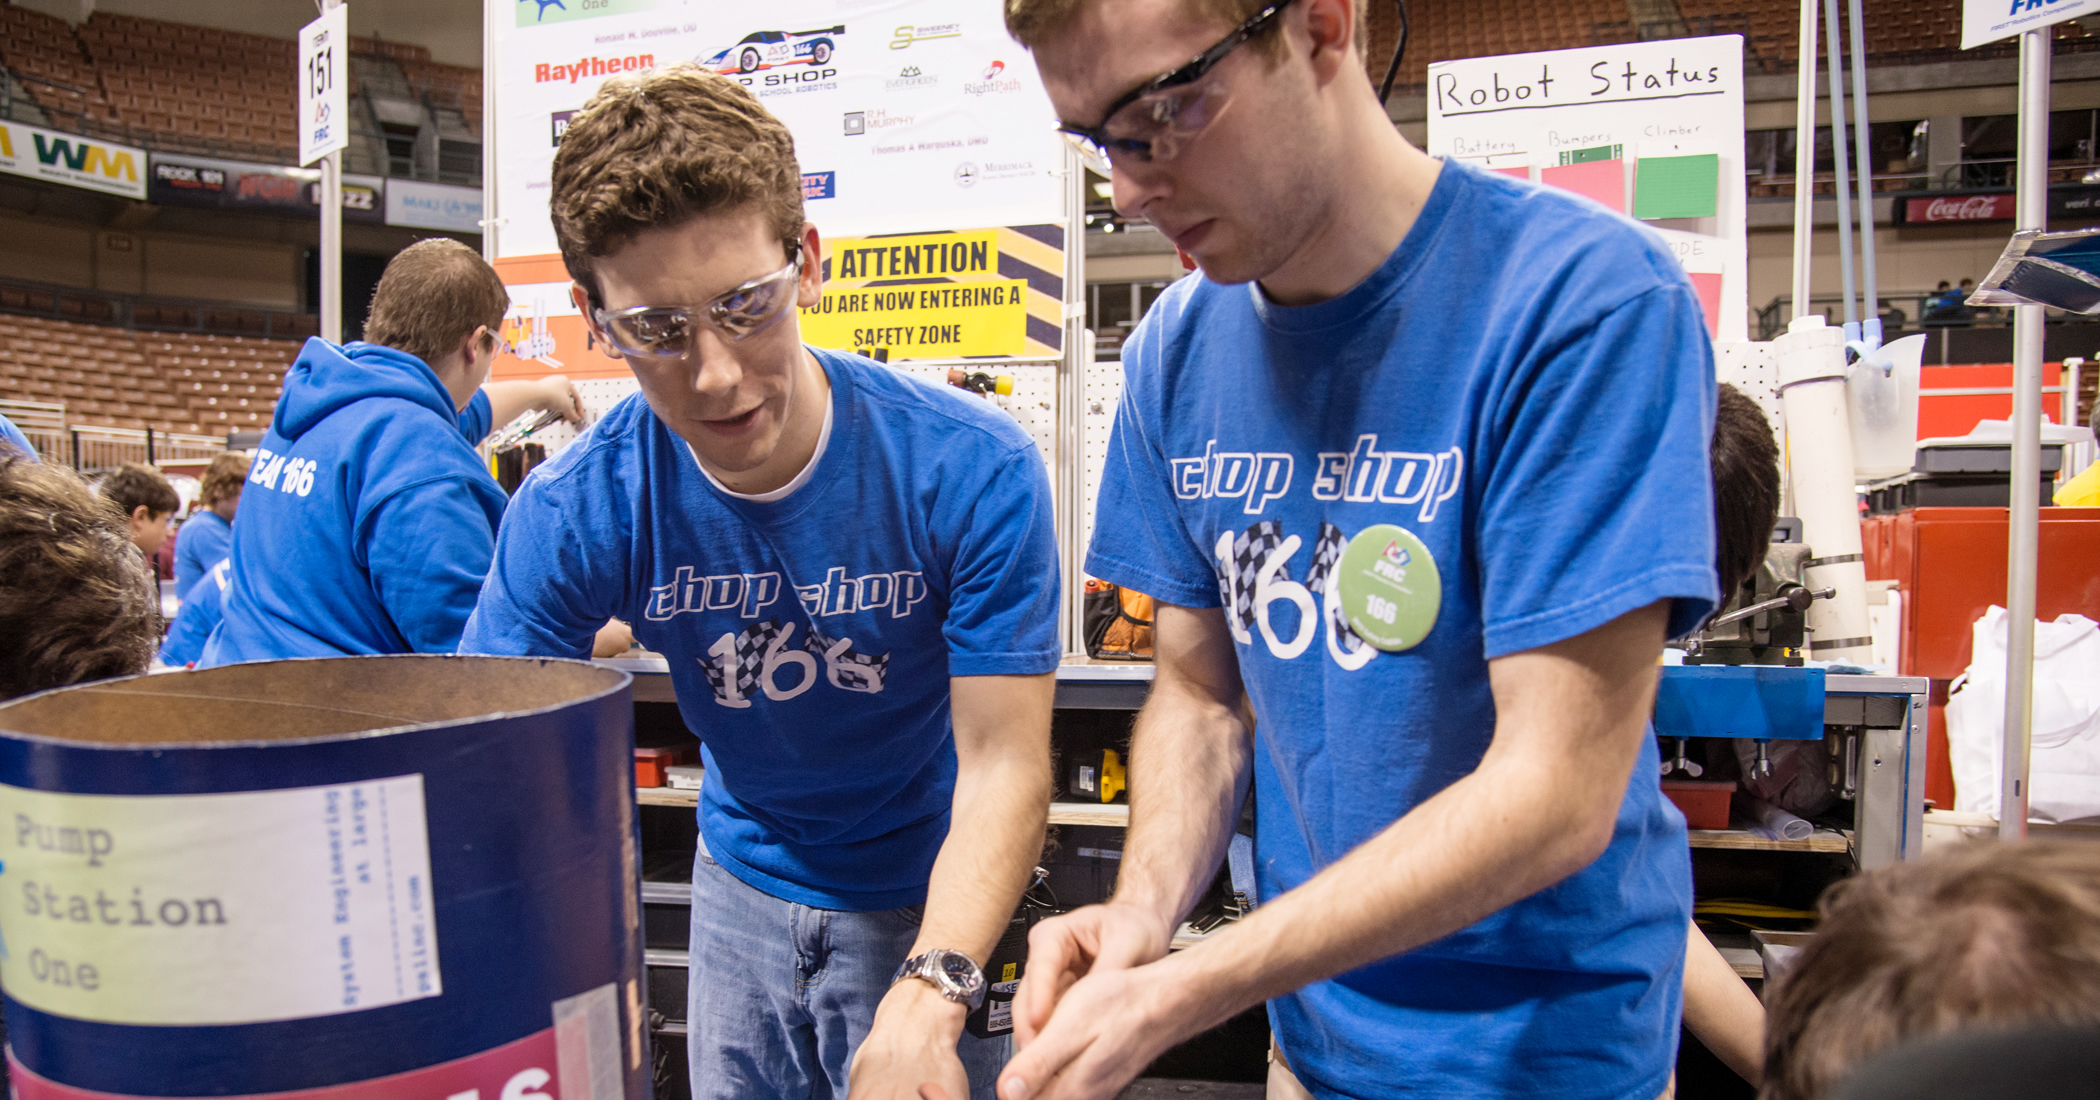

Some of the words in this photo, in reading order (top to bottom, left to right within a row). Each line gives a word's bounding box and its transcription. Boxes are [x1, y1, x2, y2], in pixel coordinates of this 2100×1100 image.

[582, 0, 609, 10] One
[2009, 0, 2059, 16] FR
[794, 42, 813, 56] 166
[308, 45, 332, 100] 151
[535, 53, 654, 84] Raytheon
[764, 68, 837, 86] SHOP
[1437, 64, 1554, 111] Robot
[1591, 57, 1719, 96] Status
[759, 86, 793, 98] SCHOOL
[796, 81, 838, 94] ROBOTICS
[964, 79, 1021, 97] RightPath
[867, 115, 915, 129] MURPHY
[1643, 125, 1701, 137] Climber
[1453, 137, 1516, 155] Battery
[1548, 131, 1611, 147] Bumpers
[32, 133, 139, 183] WM
[801, 174, 829, 187] ITY
[840, 240, 988, 279] ATTENTION
[837, 293, 869, 313] ARE
[874, 291, 915, 312] NOW
[920, 286, 1004, 310] ENTERING
[1009, 285, 1020, 305] A
[854, 326, 914, 348] SAFETY
[919, 324, 961, 345] ZONE
[281, 456, 317, 497] 166
[1170, 440, 1294, 514] chop
[1312, 434, 1464, 523] shop
[1374, 559, 1406, 583] FRC
[645, 565, 781, 621] chop
[793, 566, 927, 619] shop
[1366, 593, 1398, 625] 166
[707, 621, 882, 709] 166
[350, 787, 369, 847] large
[15, 812, 114, 868] Pump
[324, 789, 351, 925] Engineering
[356, 860, 372, 886] at
[22, 880, 229, 927] Station
[29, 947, 100, 992] One
[338, 934, 360, 1007] System
